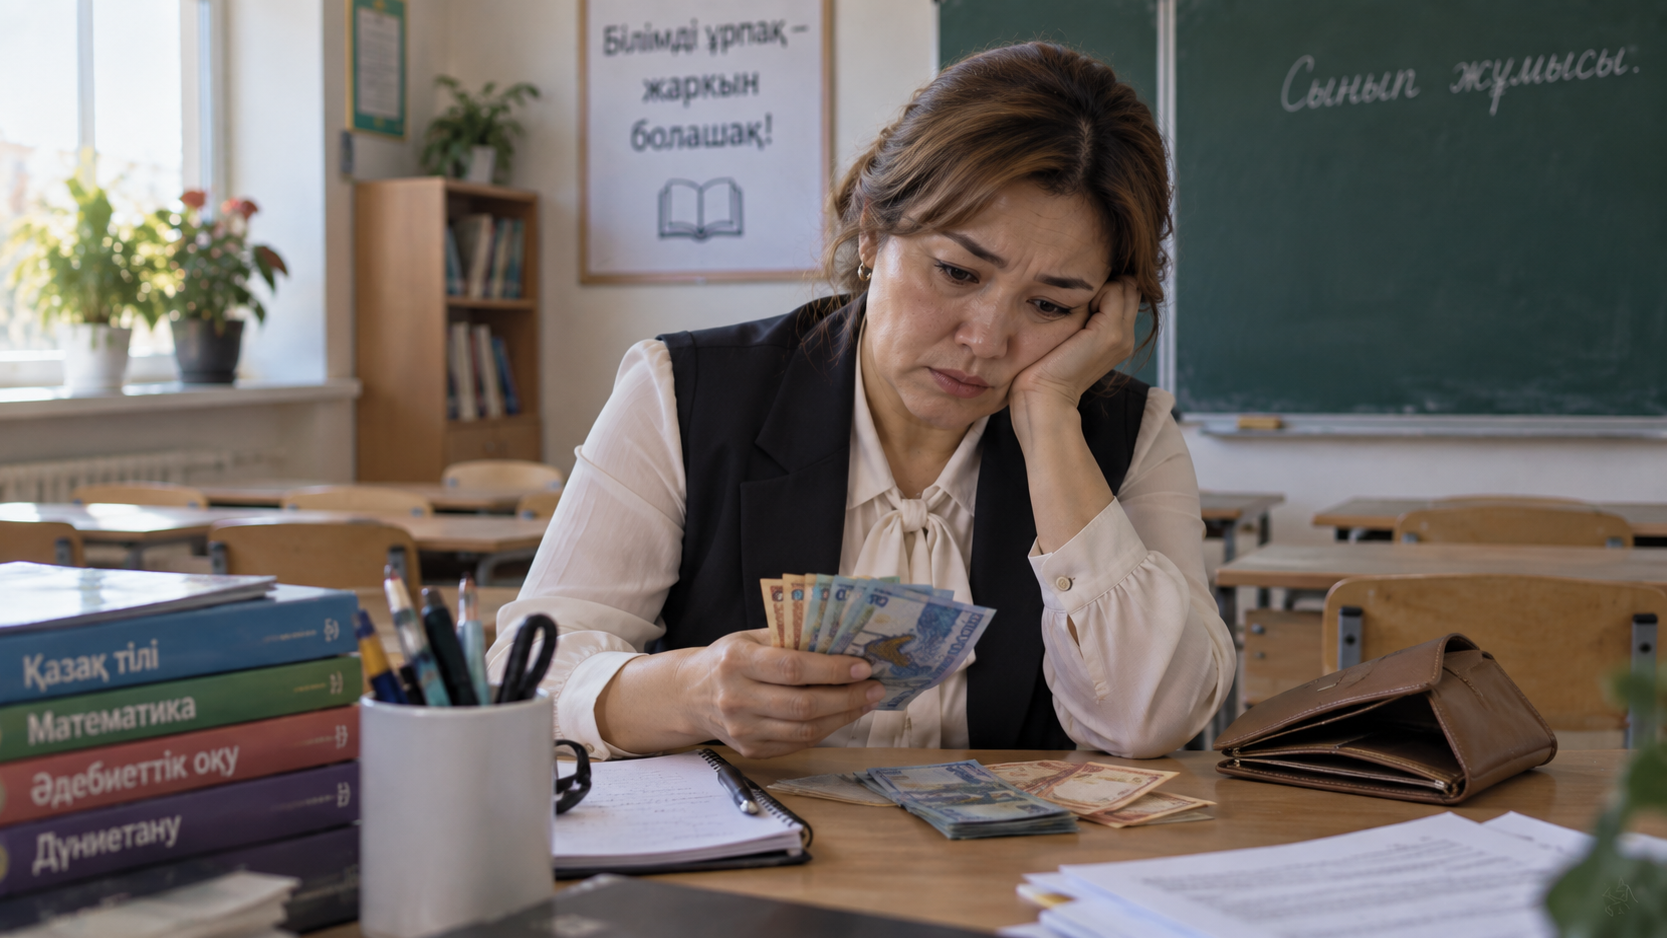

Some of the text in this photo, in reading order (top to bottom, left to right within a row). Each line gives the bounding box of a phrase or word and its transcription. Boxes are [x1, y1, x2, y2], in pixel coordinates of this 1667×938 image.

[602, 18, 698, 56] Білімді
[705, 19, 788, 56] ұрпақ
[1281, 54, 1419, 112] Сынып
[631, 112, 772, 152] болашақ!
[23, 639, 159, 691] Қазақ тілі
[27, 696, 197, 745] Математика
[31, 745, 240, 809] Әдебиеттік оқу
[32, 815, 182, 876] Дүниетану
